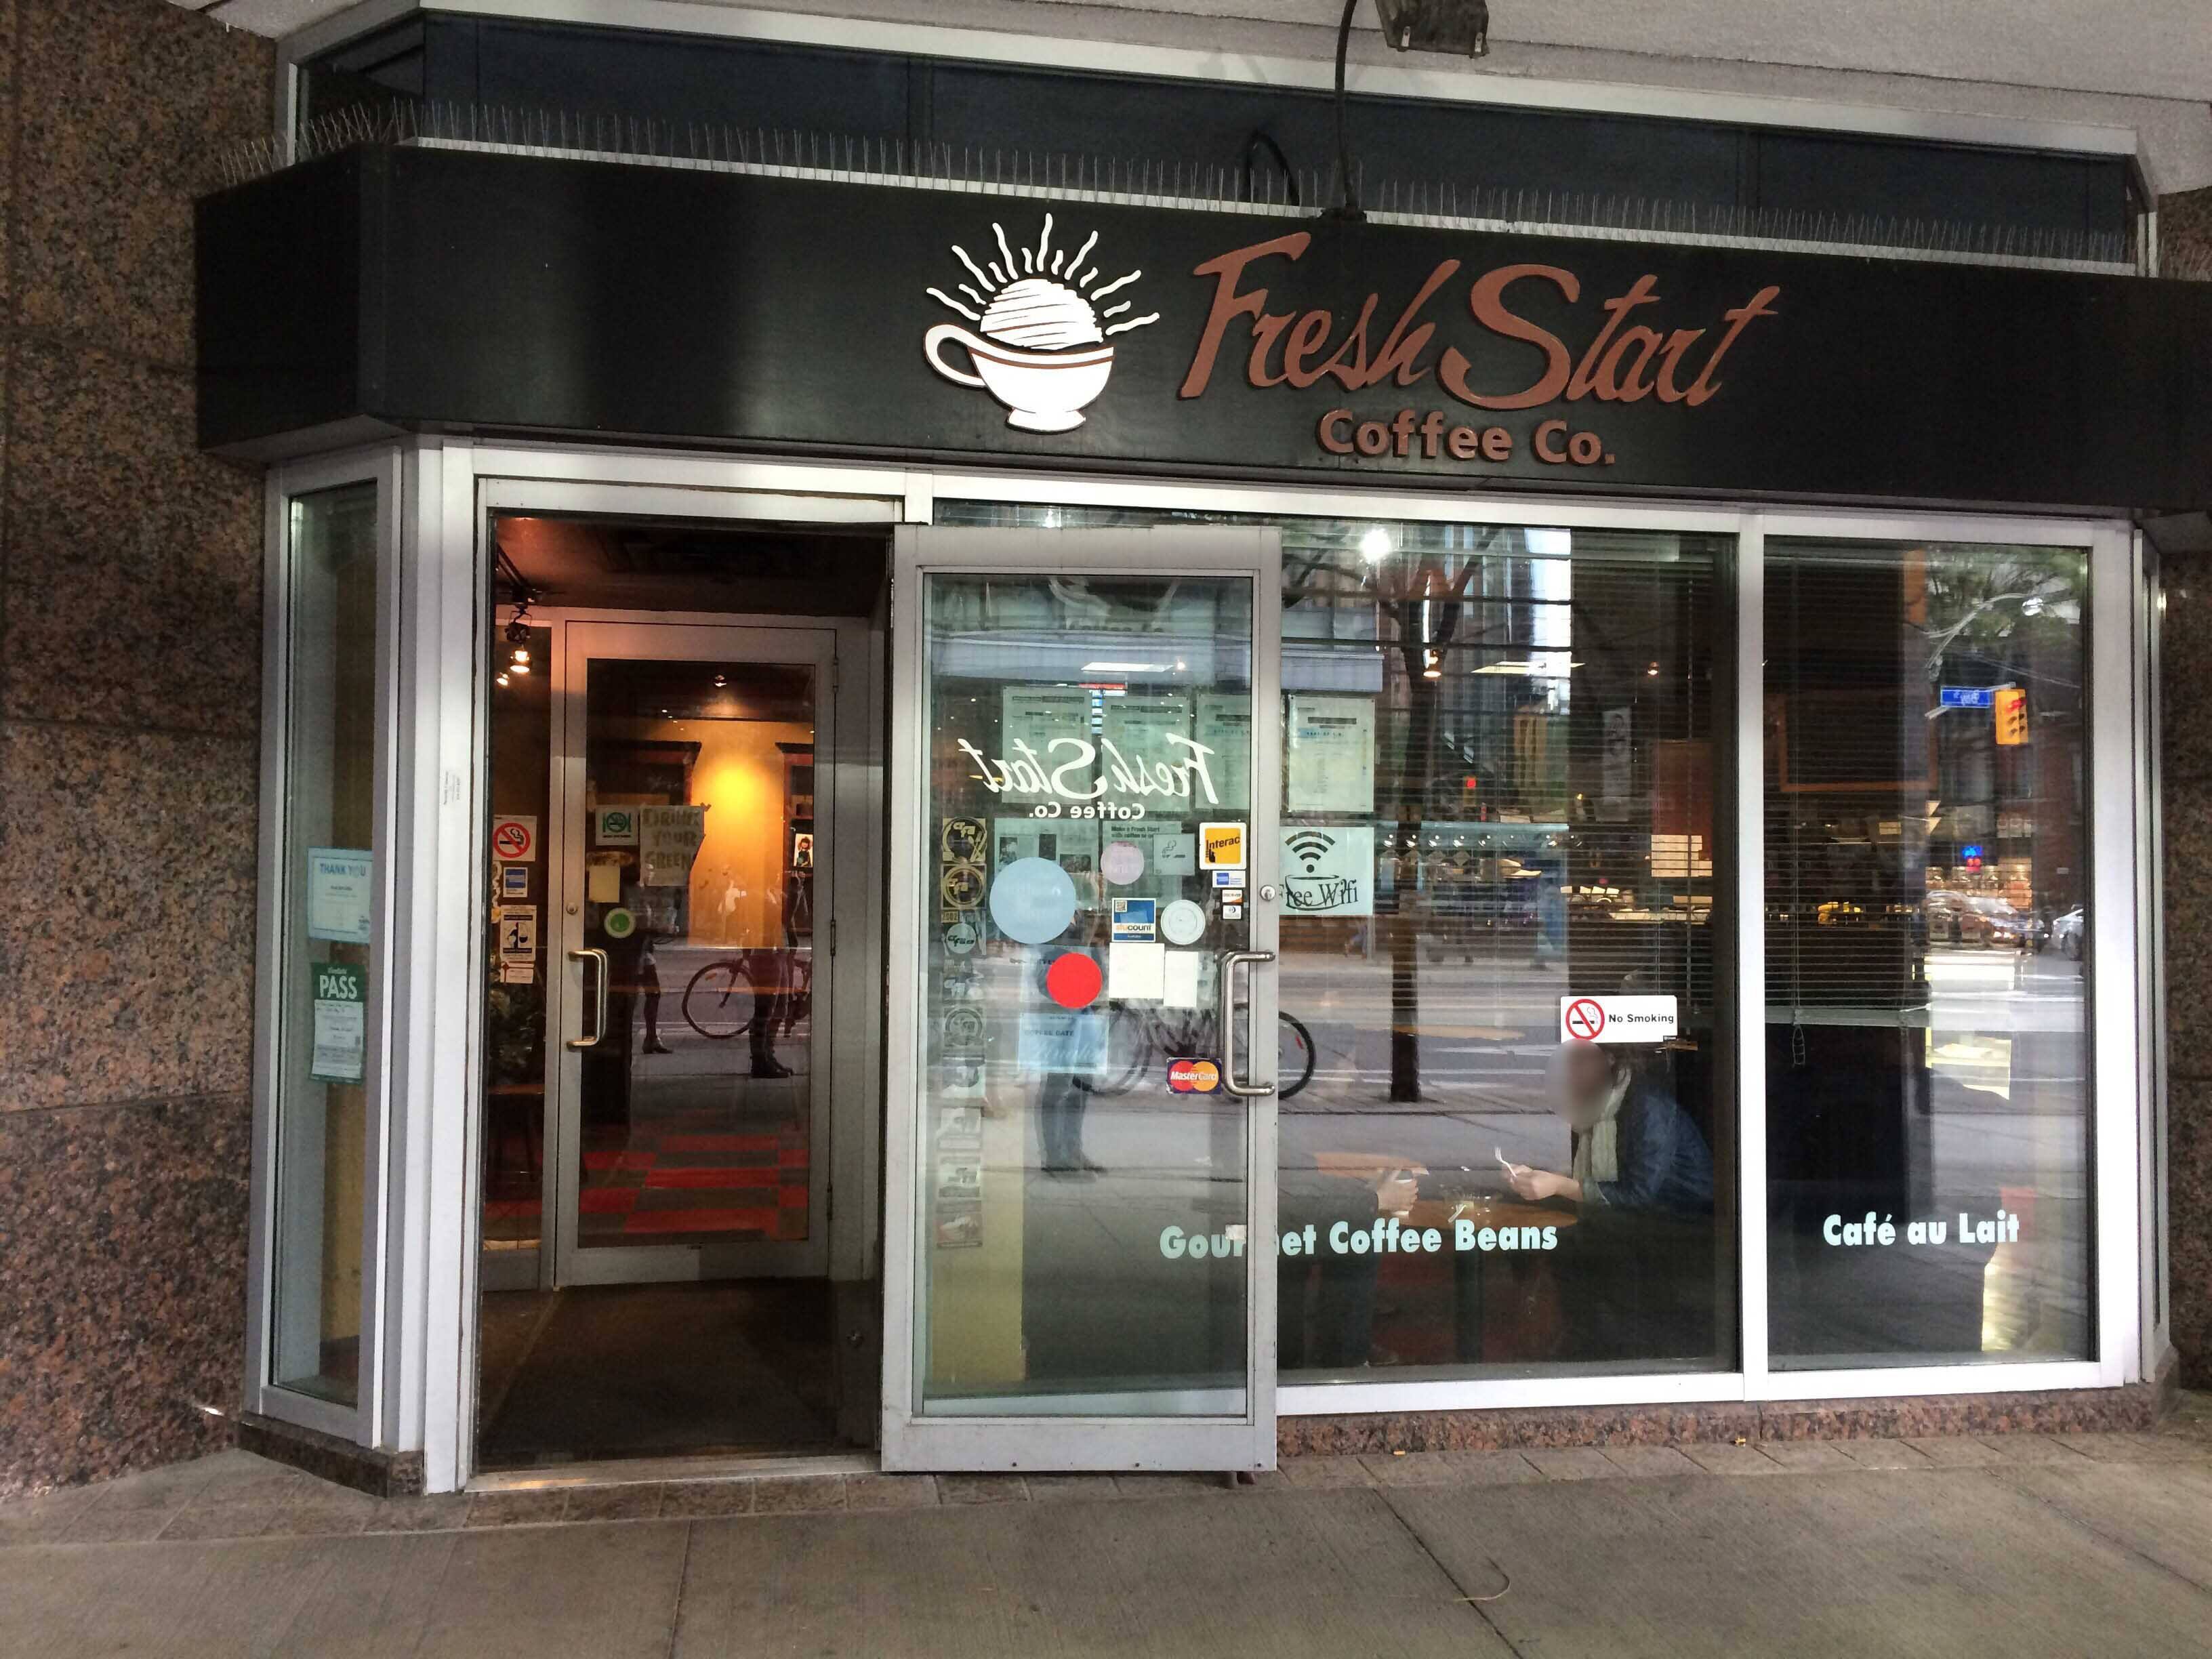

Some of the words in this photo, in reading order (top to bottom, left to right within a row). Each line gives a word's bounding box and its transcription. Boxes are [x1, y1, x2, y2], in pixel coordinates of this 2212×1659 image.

[1179, 231, 1460, 400] Fresh
[1437, 263, 1780, 409] Start
[1318, 408, 1514, 462] Coffee
[1533, 419, 1616, 466] Co.
[1205, 836, 1241, 853] Interac
[319, 863, 347, 876] THANK
[319, 975, 358, 1000] PASS
[1608, 1014, 1623, 1023] No
[1627, 1014, 1674, 1024] Smoking
[1170, 1071, 1217, 1080] MasterCard
[1160, 1224, 1317, 1259] Gouret
[1329, 1217, 1442, 1254] Coffee
[1455, 1219, 1557, 1252] Beans
[1823, 1211, 1897, 1246] Café
[1906, 1221, 1948, 1245] au
[1959, 1208, 2020, 1244] Lait
